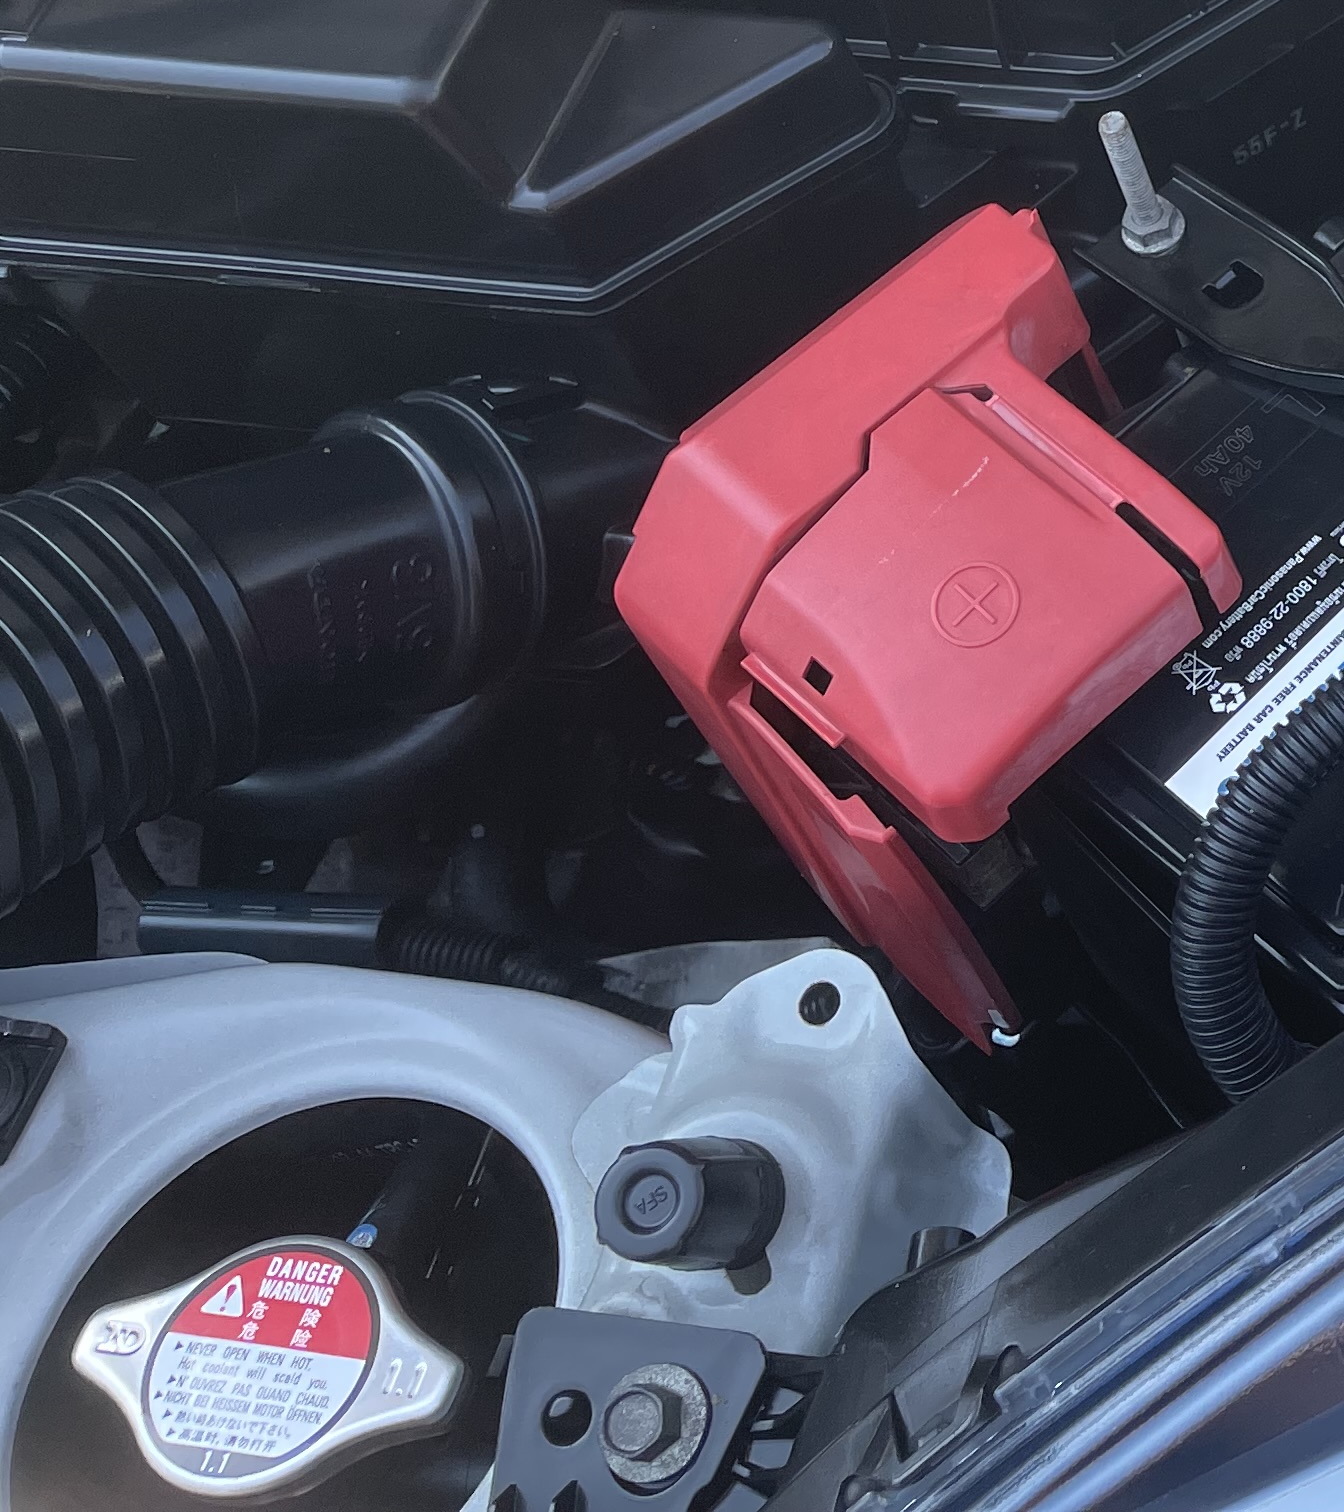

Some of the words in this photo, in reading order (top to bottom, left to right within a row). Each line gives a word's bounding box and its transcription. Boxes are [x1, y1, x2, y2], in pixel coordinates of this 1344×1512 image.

[1192, 424, 1255, 476] 40Ah
[1217, 451, 1264, 496] 12V
[1200, 534, 1322, 649] www.PanasonicCarBattery.com
[1239, 574, 1319, 649] 1800-22-9888
[1271, 680, 1296, 706] FREE
[1250, 702, 1273, 725] CAR
[1213, 720, 1255, 762] BATTERY
[266, 1256, 344, 1285] DANGER
[257, 1278, 335, 1306] WARNUNG
[185, 1341, 216, 1357] NEVER
[223, 1346, 250, 1361] OPEN
[257, 1351, 285, 1366] WHEN
[189, 1377, 227, 1393] OUVREZ
[231, 1383, 252, 1397] PAS
[247, 1368, 267, 1380] will
[163, 1390, 191, 1406] NICHT
[193, 1395, 210, 1408] BEI
[252, 1403, 284, 1419] MOTOR
[198, 1450, 232, 1475] 1.1
